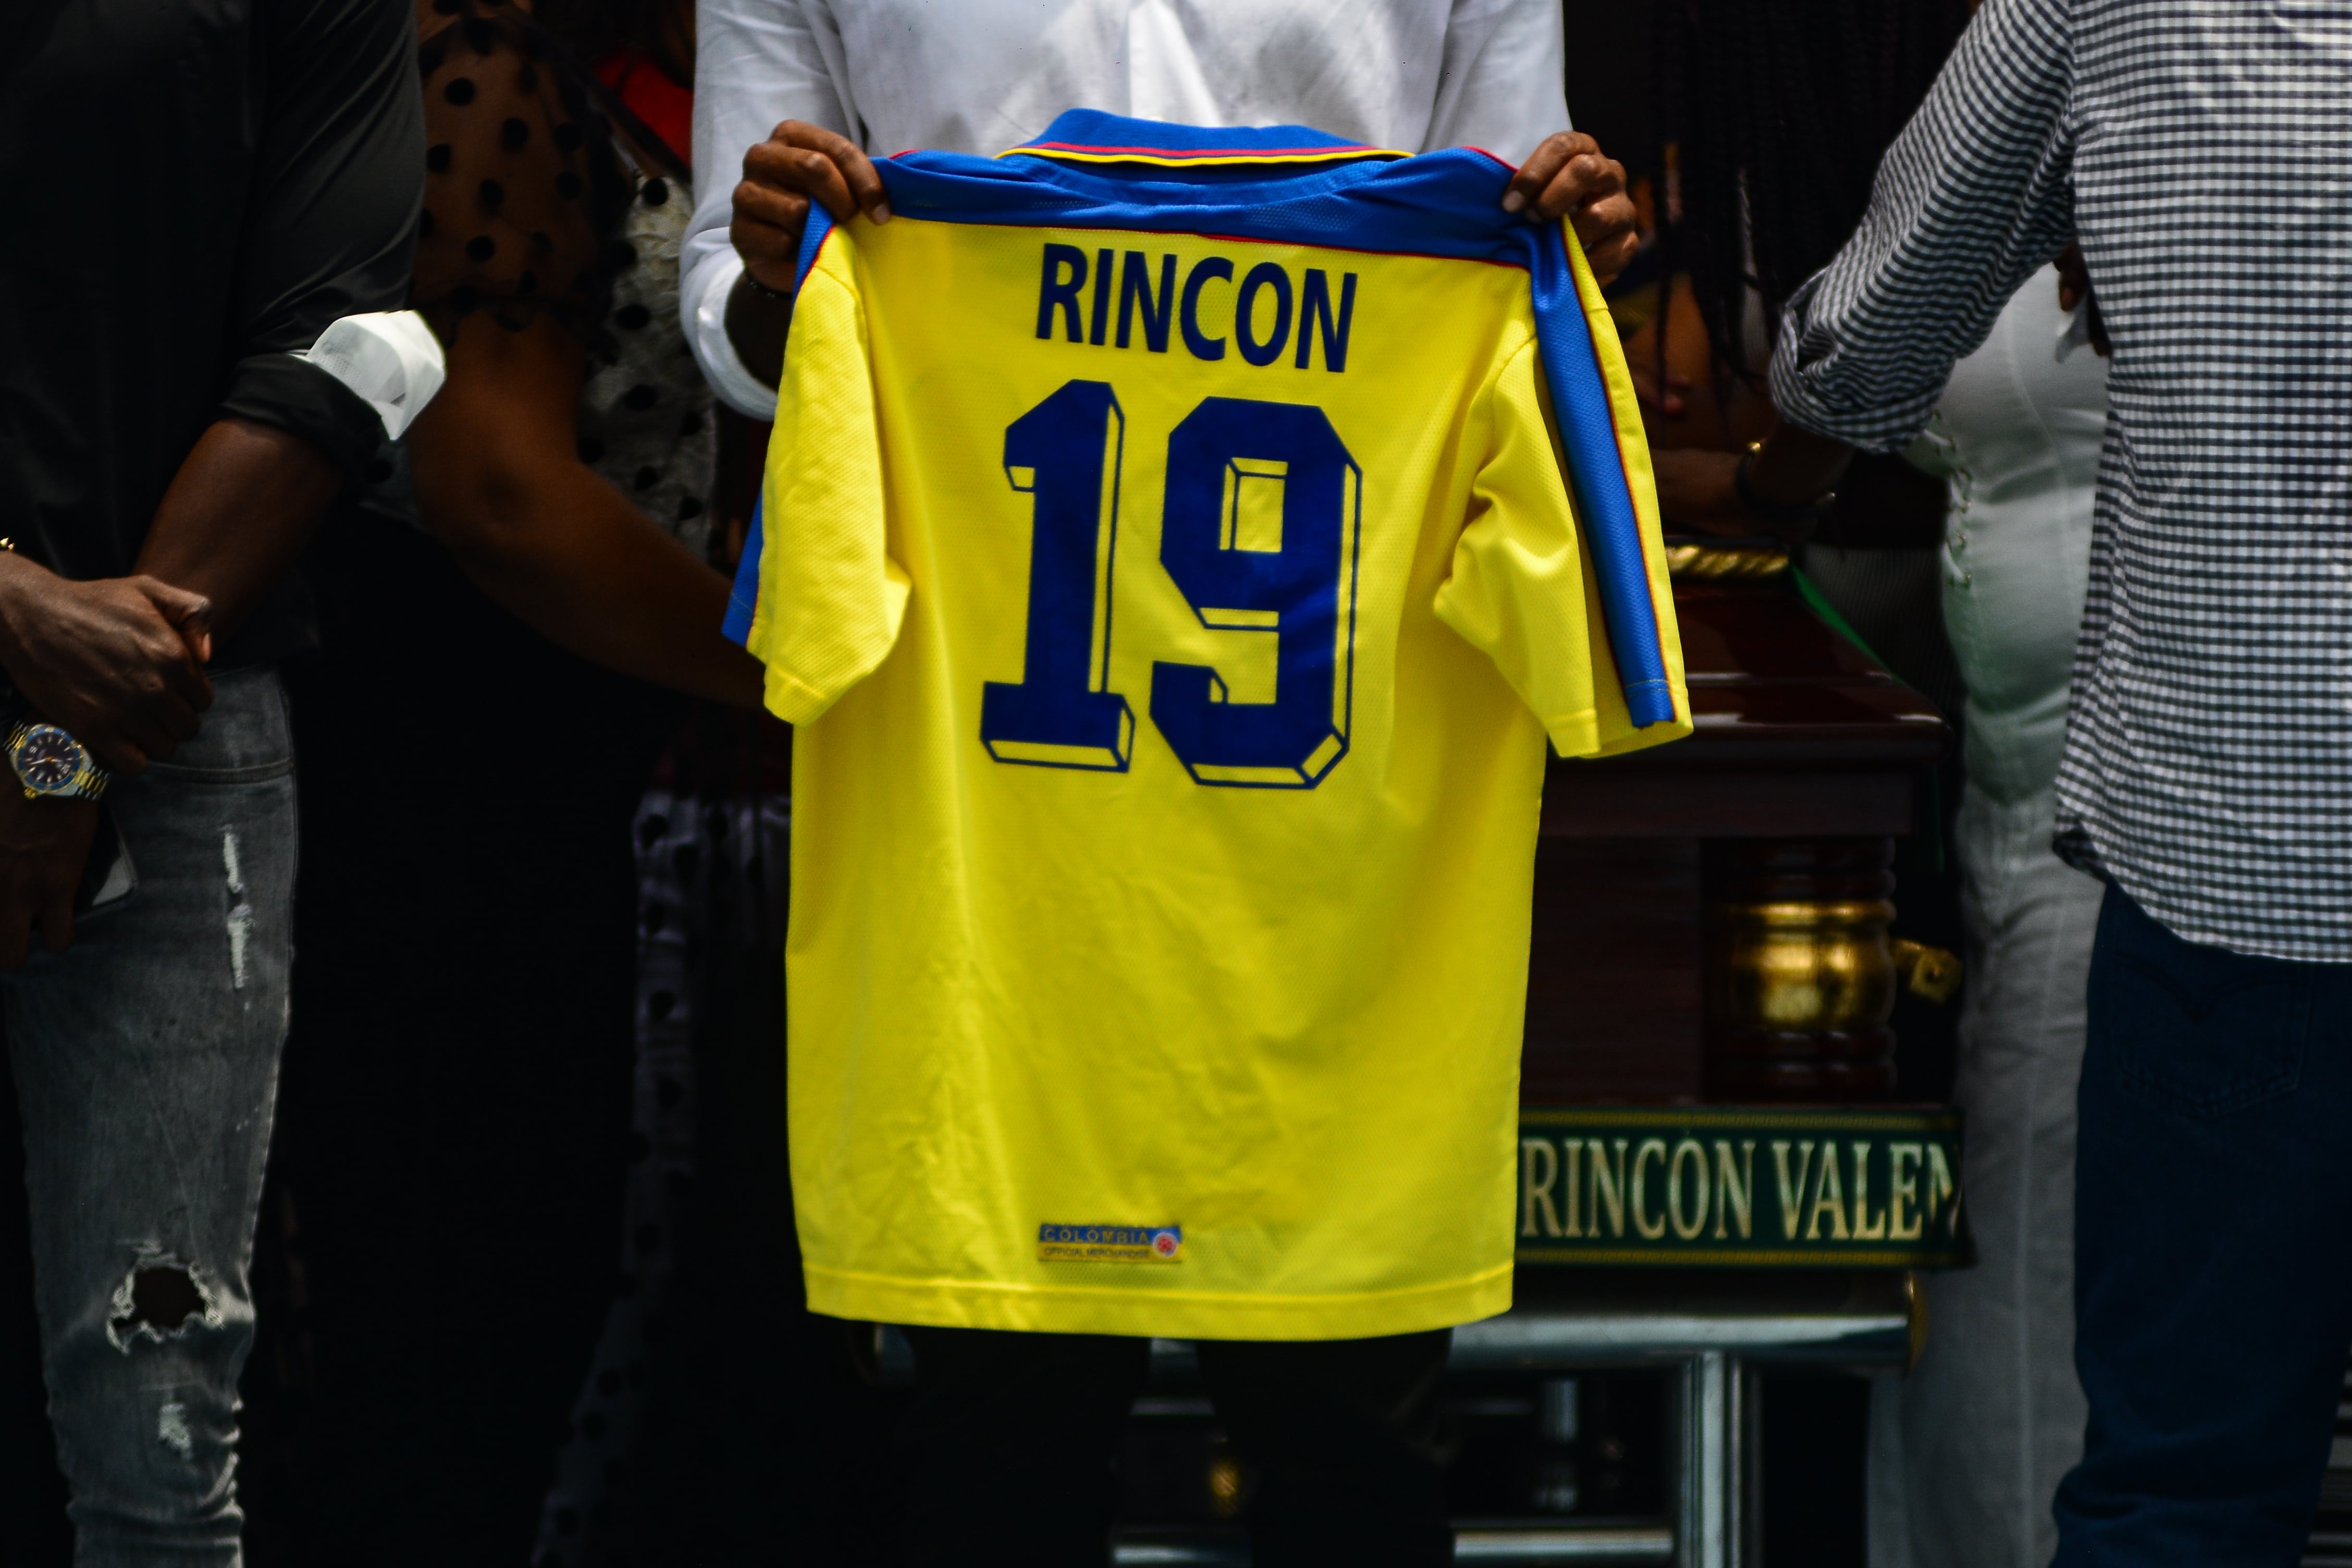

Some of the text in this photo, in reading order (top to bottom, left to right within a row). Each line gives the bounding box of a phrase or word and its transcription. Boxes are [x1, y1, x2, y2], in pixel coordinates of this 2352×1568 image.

[1036, 242, 1358, 373] RINCON
[980, 378, 1362, 790] 19
[1044, 1228, 1150, 1244] COLOMBIA
[1521, 1137, 1756, 1240] RINCON
[1044, 1247, 1082, 1256] OFFICIAL
